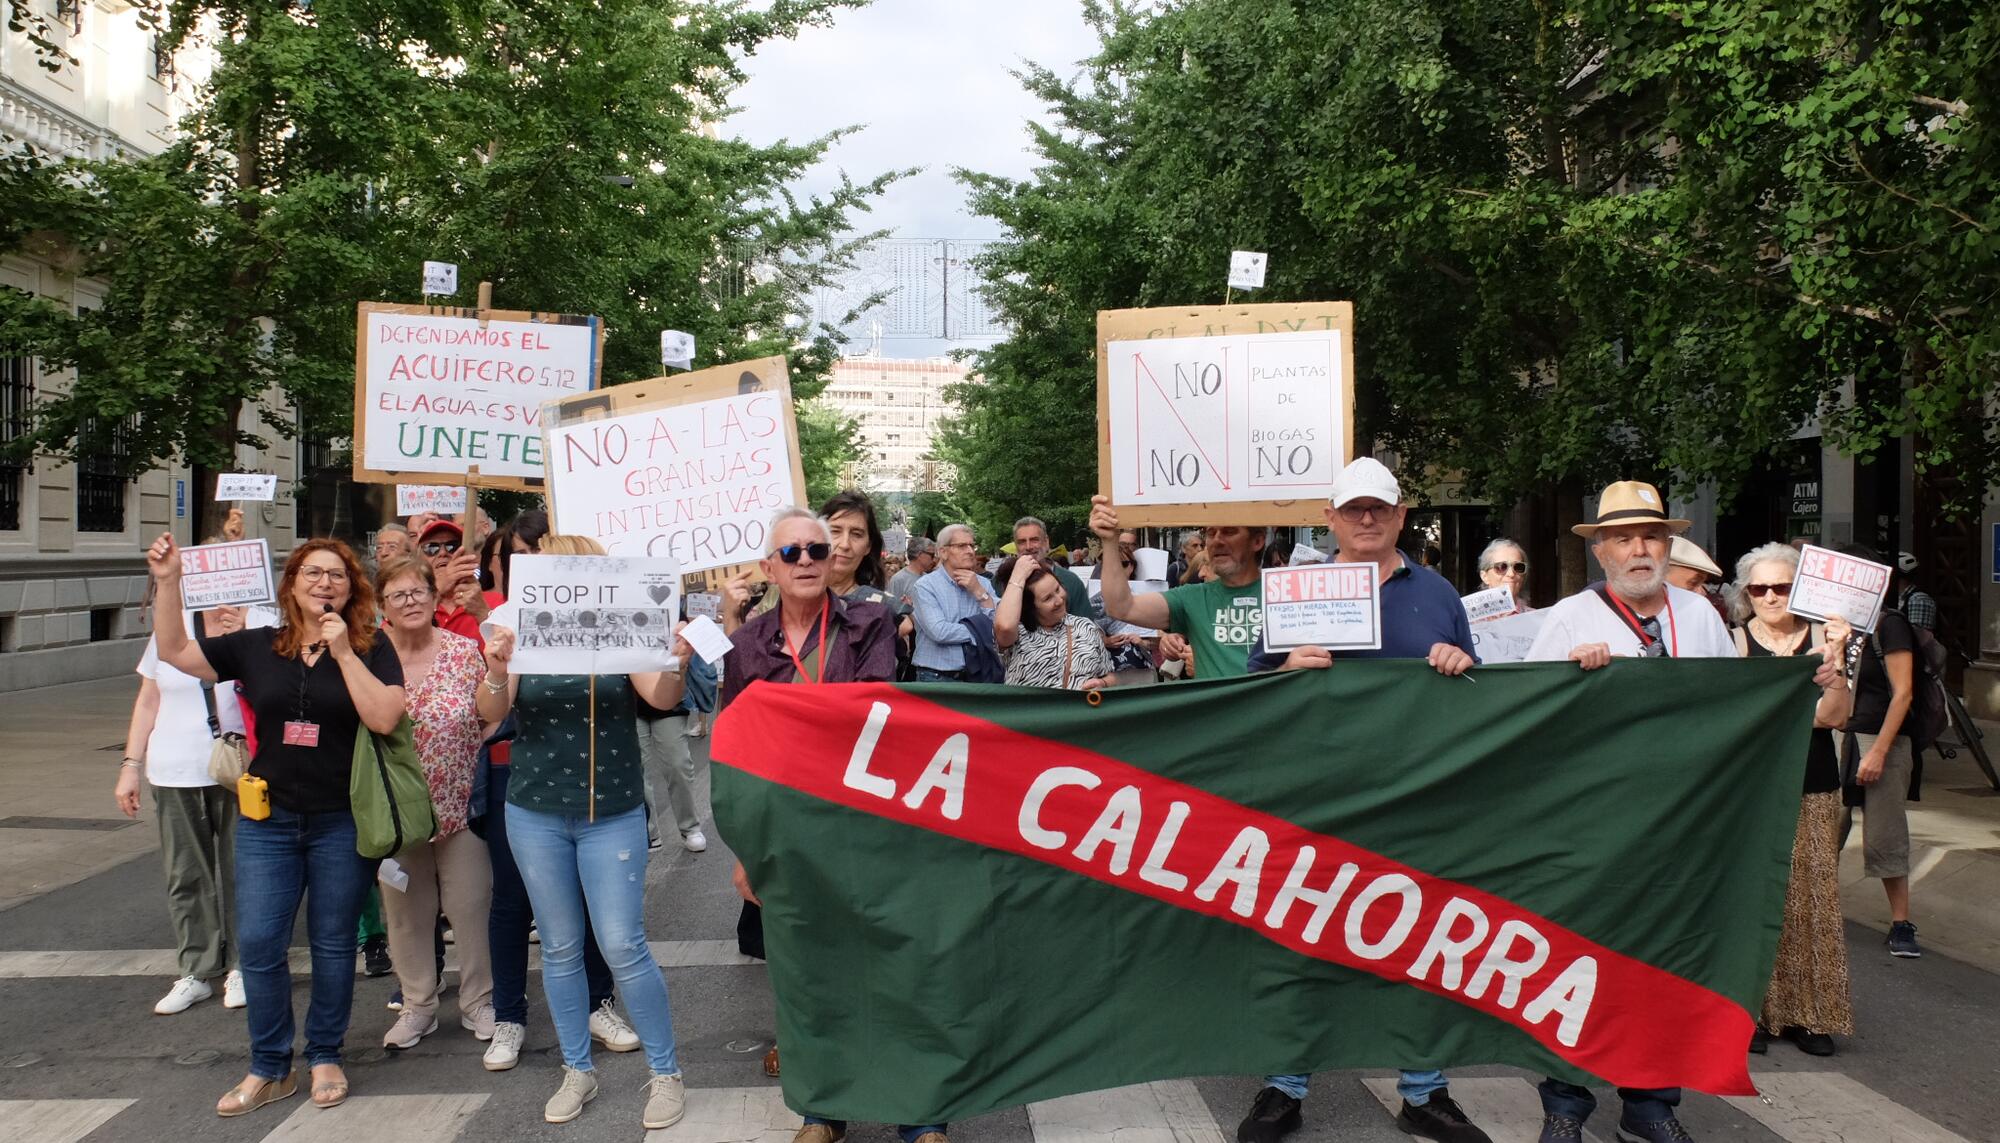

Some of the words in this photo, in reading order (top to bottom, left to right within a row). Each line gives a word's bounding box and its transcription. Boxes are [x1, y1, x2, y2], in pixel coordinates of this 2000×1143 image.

[380, 324, 513, 347] DEFENDAMOS
[521, 332, 550, 350] EL
[1174, 361, 1222, 399] NO
[1252, 366, 1327, 381] PLANTAS
[1278, 392, 1297, 405] DE
[1251, 427, 1316, 443] BIOGAS
[624, 448, 773, 497] GRANJAS
[1151, 449, 1200, 487] NO
[1256, 445, 1313, 478] NO
[1793, 482, 1818, 498] ATM
[595, 482, 783, 537] INTENSIVAS
[1792, 501, 1818, 515] Cajero
[181, 551, 202, 574] SE
[205, 543, 263, 572] VENDE
[1803, 551, 1827, 578] SE
[1832, 556, 1886, 593] VENDE
[521, 584, 589, 604] STOP
[598, 585, 620, 604] IT
[1267, 573, 1293, 602] SE
[1299, 568, 1371, 600] VENDE
[843, 701, 969, 820] LA
[1018, 766, 1598, 1048] CALAHORRA
